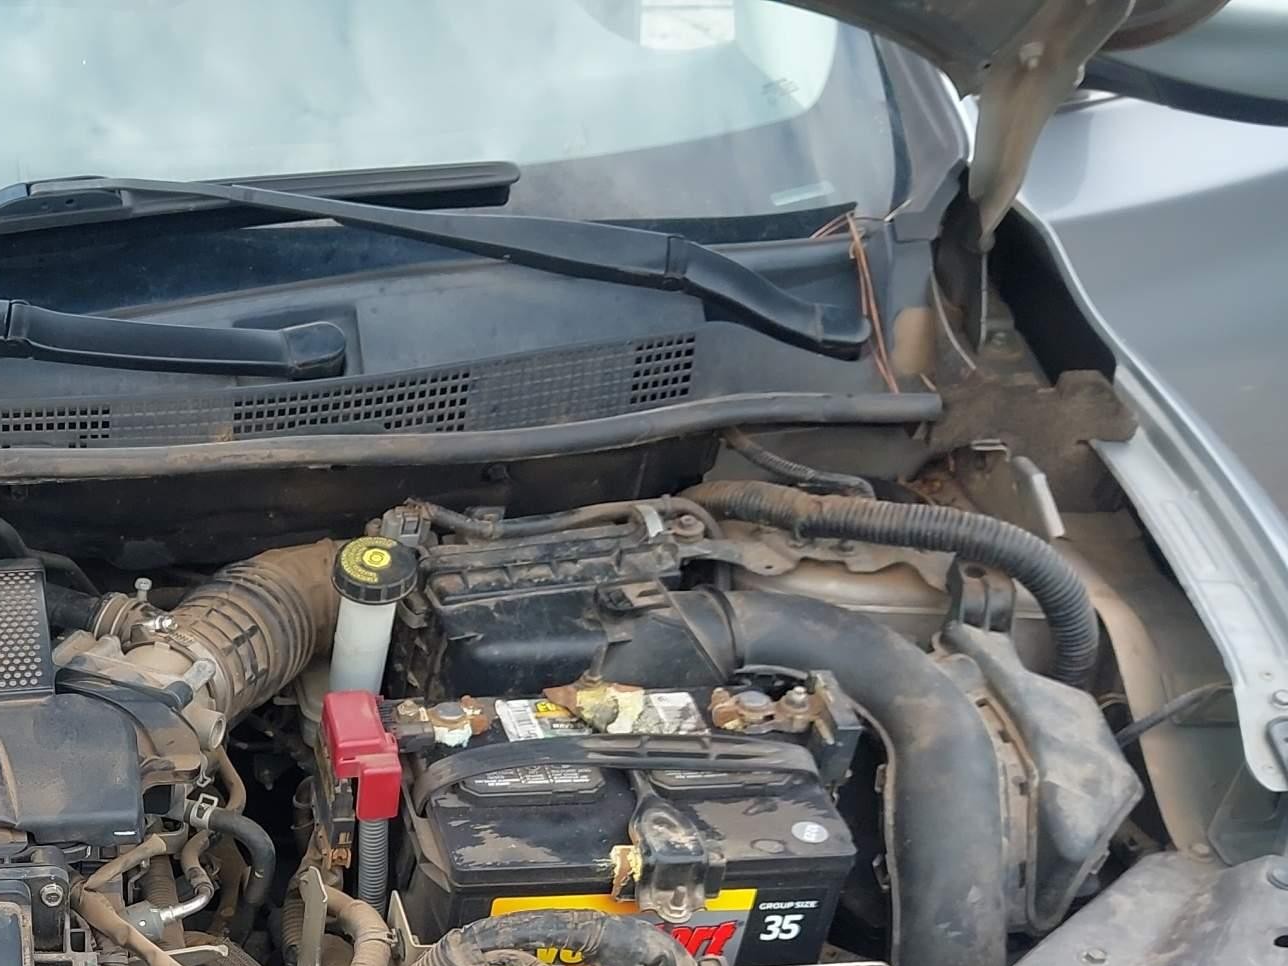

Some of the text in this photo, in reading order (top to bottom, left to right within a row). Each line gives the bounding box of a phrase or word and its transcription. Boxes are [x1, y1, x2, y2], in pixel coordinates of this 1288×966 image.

[758, 899, 820, 911] GROUP SIZE
[759, 914, 804, 941] 35
